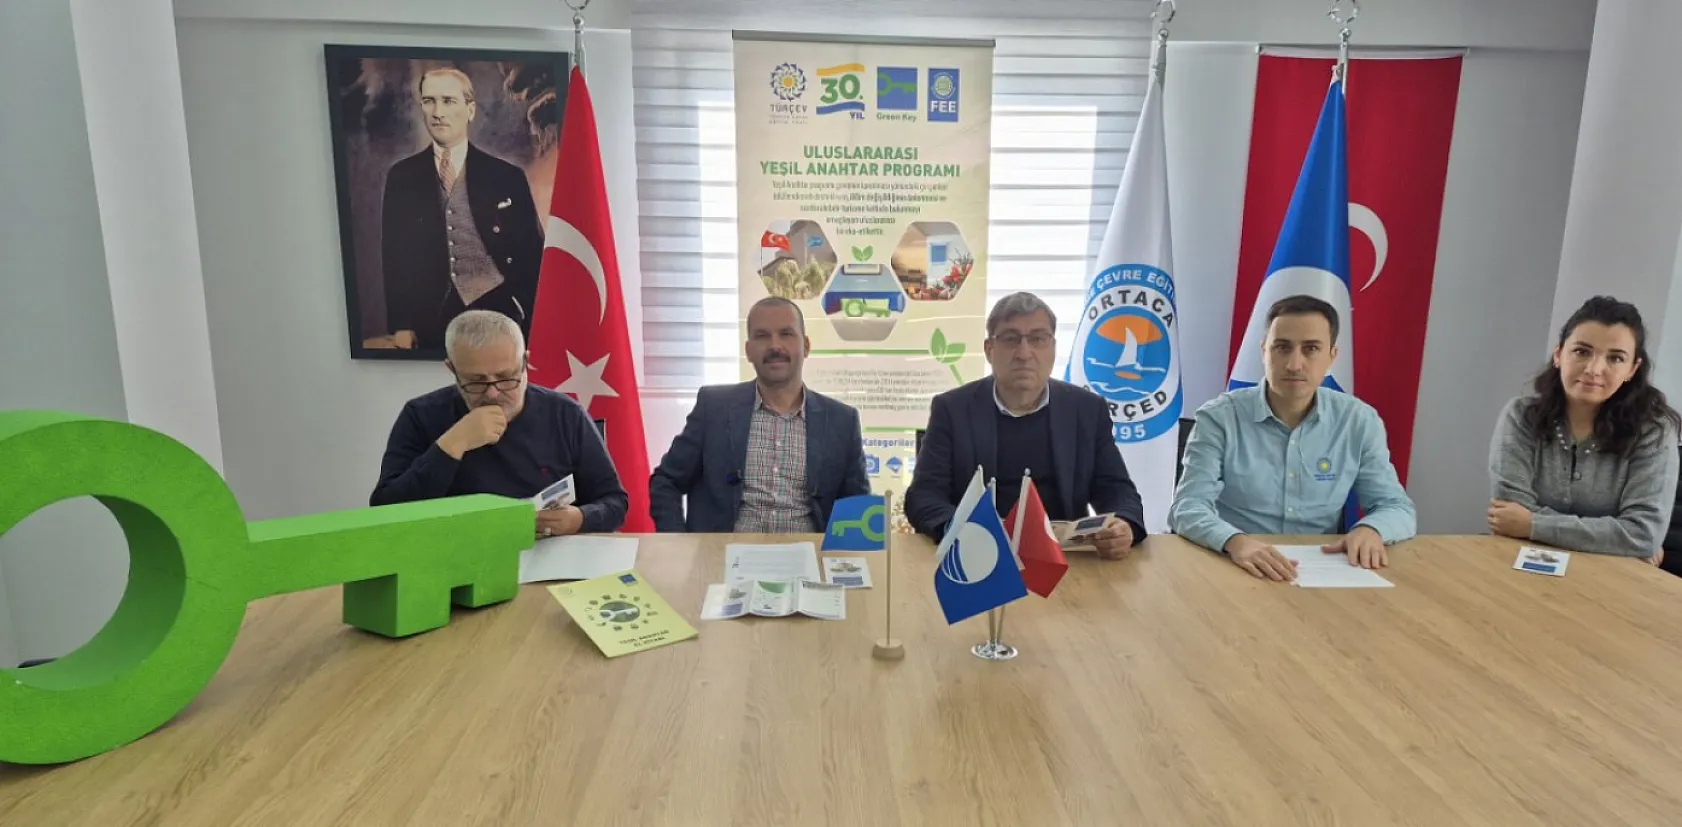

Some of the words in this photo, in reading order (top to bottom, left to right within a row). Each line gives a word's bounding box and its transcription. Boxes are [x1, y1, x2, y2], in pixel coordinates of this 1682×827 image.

[930, 100, 957, 113] FEE
[849, 111, 865, 120] YIL
[876, 112, 900, 121] Green
[902, 112, 917, 123] Key
[803, 145, 919, 160] ULUSLARARASI
[806, 161, 879, 177] ANAHTAR
[883, 163, 961, 178] PROGRAMI
[1097, 269, 1142, 291] ÇEVRE
[1088, 289, 1173, 328] ORTACA
